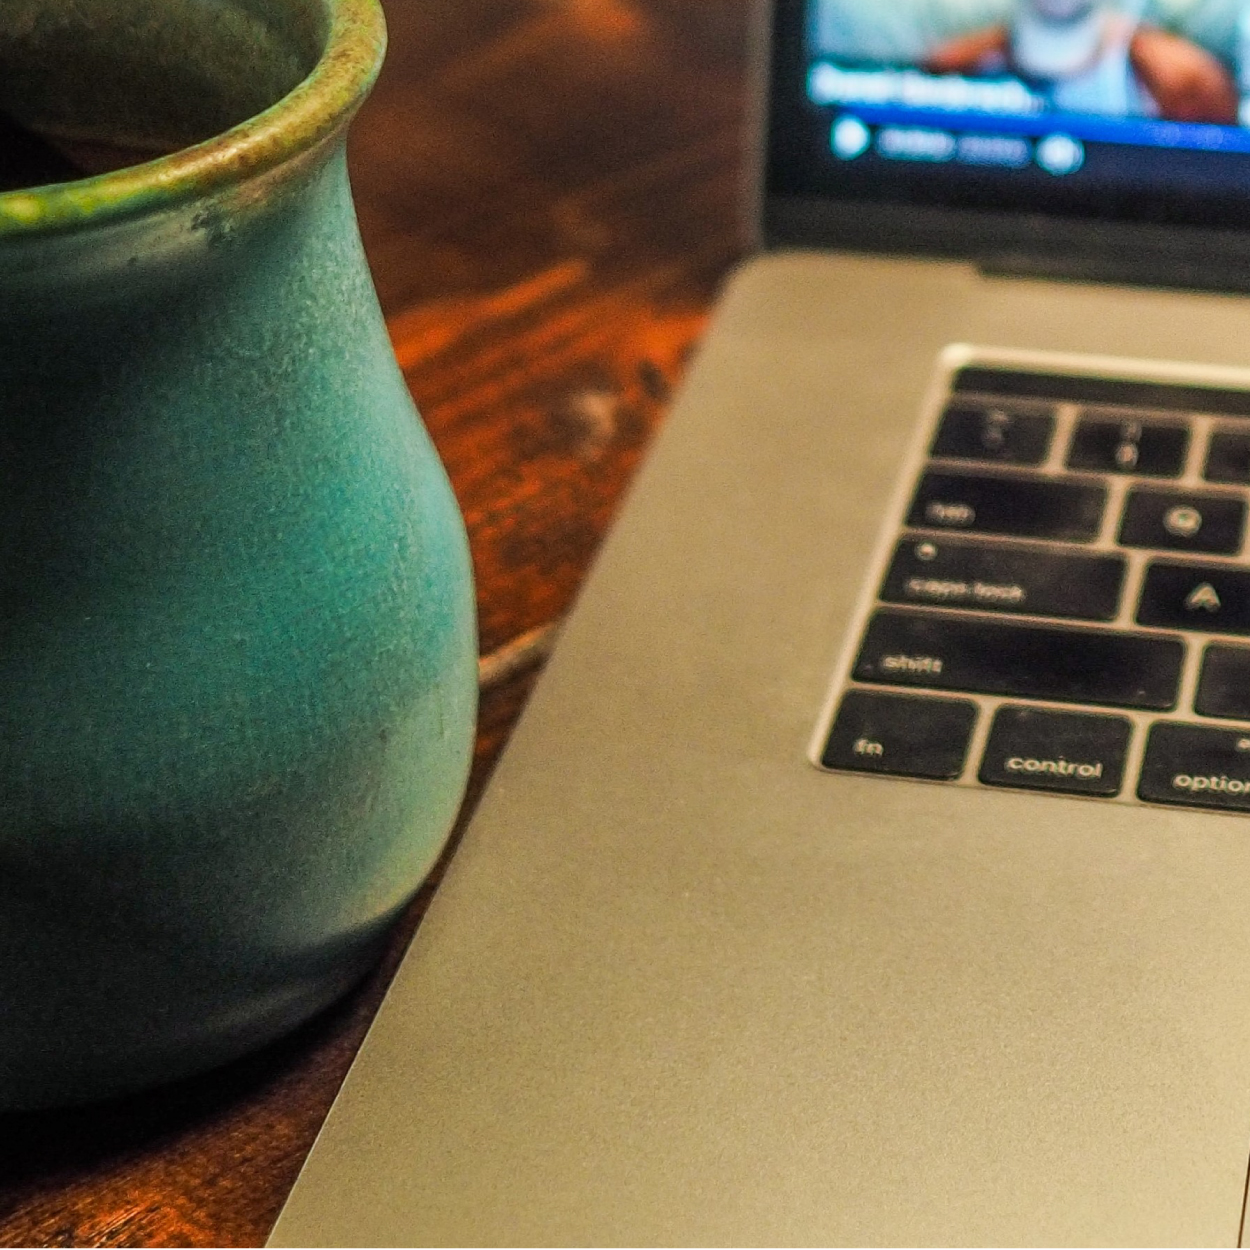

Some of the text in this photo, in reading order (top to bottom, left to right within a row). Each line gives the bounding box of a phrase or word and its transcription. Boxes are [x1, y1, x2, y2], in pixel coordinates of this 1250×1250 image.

[1166, 506, 1202, 535] Q
[1188, 584, 1220, 608] A
[882, 654, 943, 674] shift
[854, 738, 884, 756] fn
[1006, 755, 1103, 778] control
